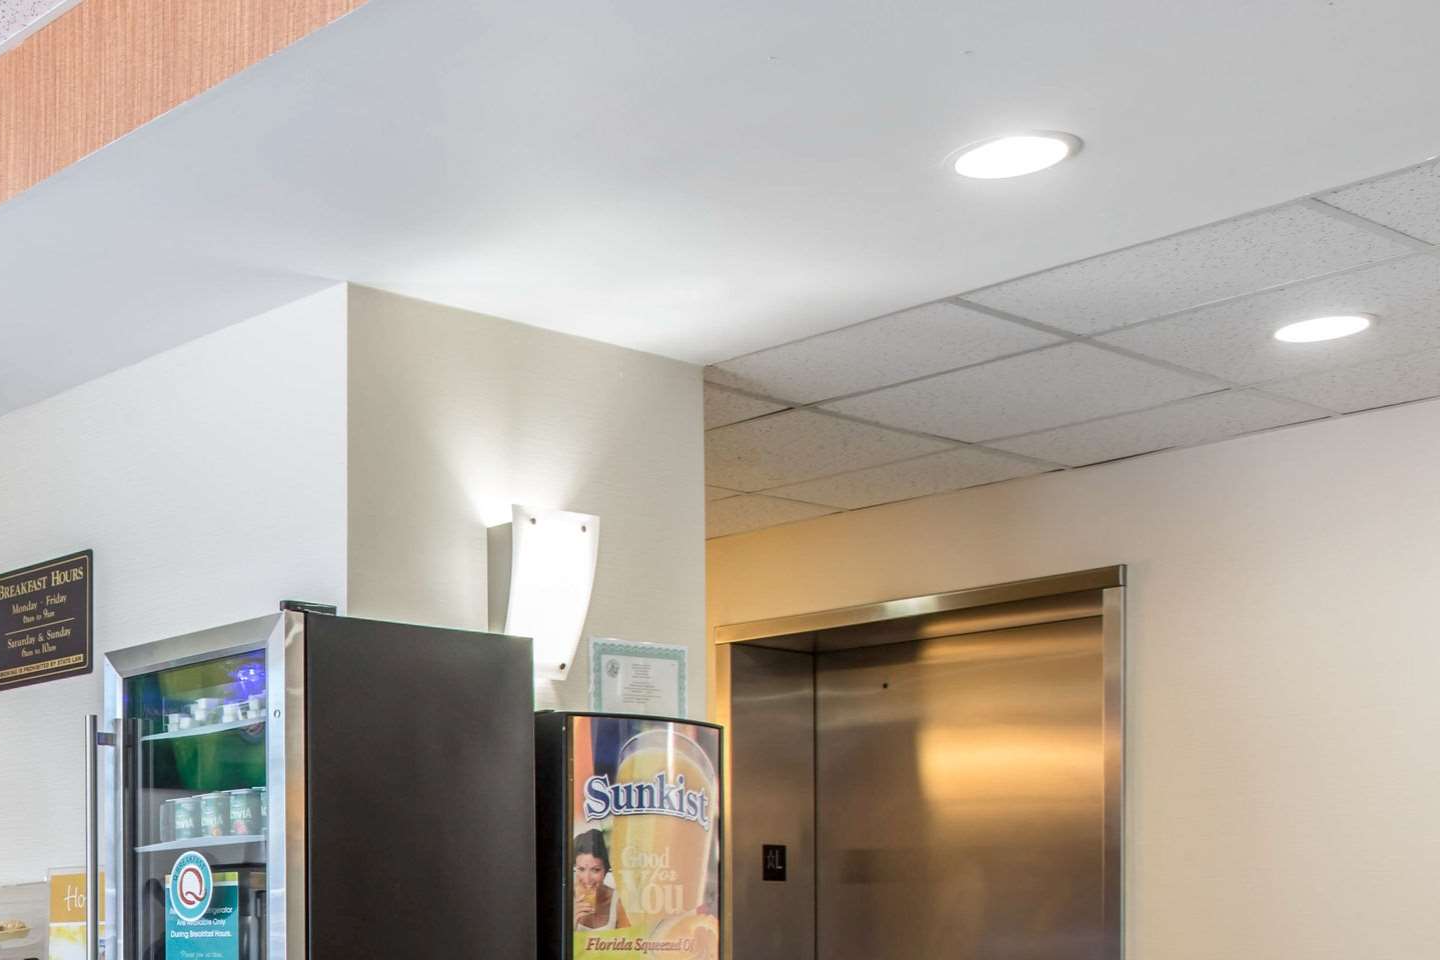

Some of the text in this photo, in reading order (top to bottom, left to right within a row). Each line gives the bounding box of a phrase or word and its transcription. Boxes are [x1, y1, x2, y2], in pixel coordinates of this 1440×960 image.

[51, 566, 83, 586] HOURS
[12, 601, 38, 614] Monday
[45, 592, 67, 605] Friday
[7, 634, 36, 649] Saturday
[46, 626, 72, 641] Sunday
[584, 772, 709, 831] Sunkist
[621, 847, 671, 869] Good
[64, 884, 87, 912] Ho
[170, 930, 189, 939] During
[586, 937, 633, 951] Florida
